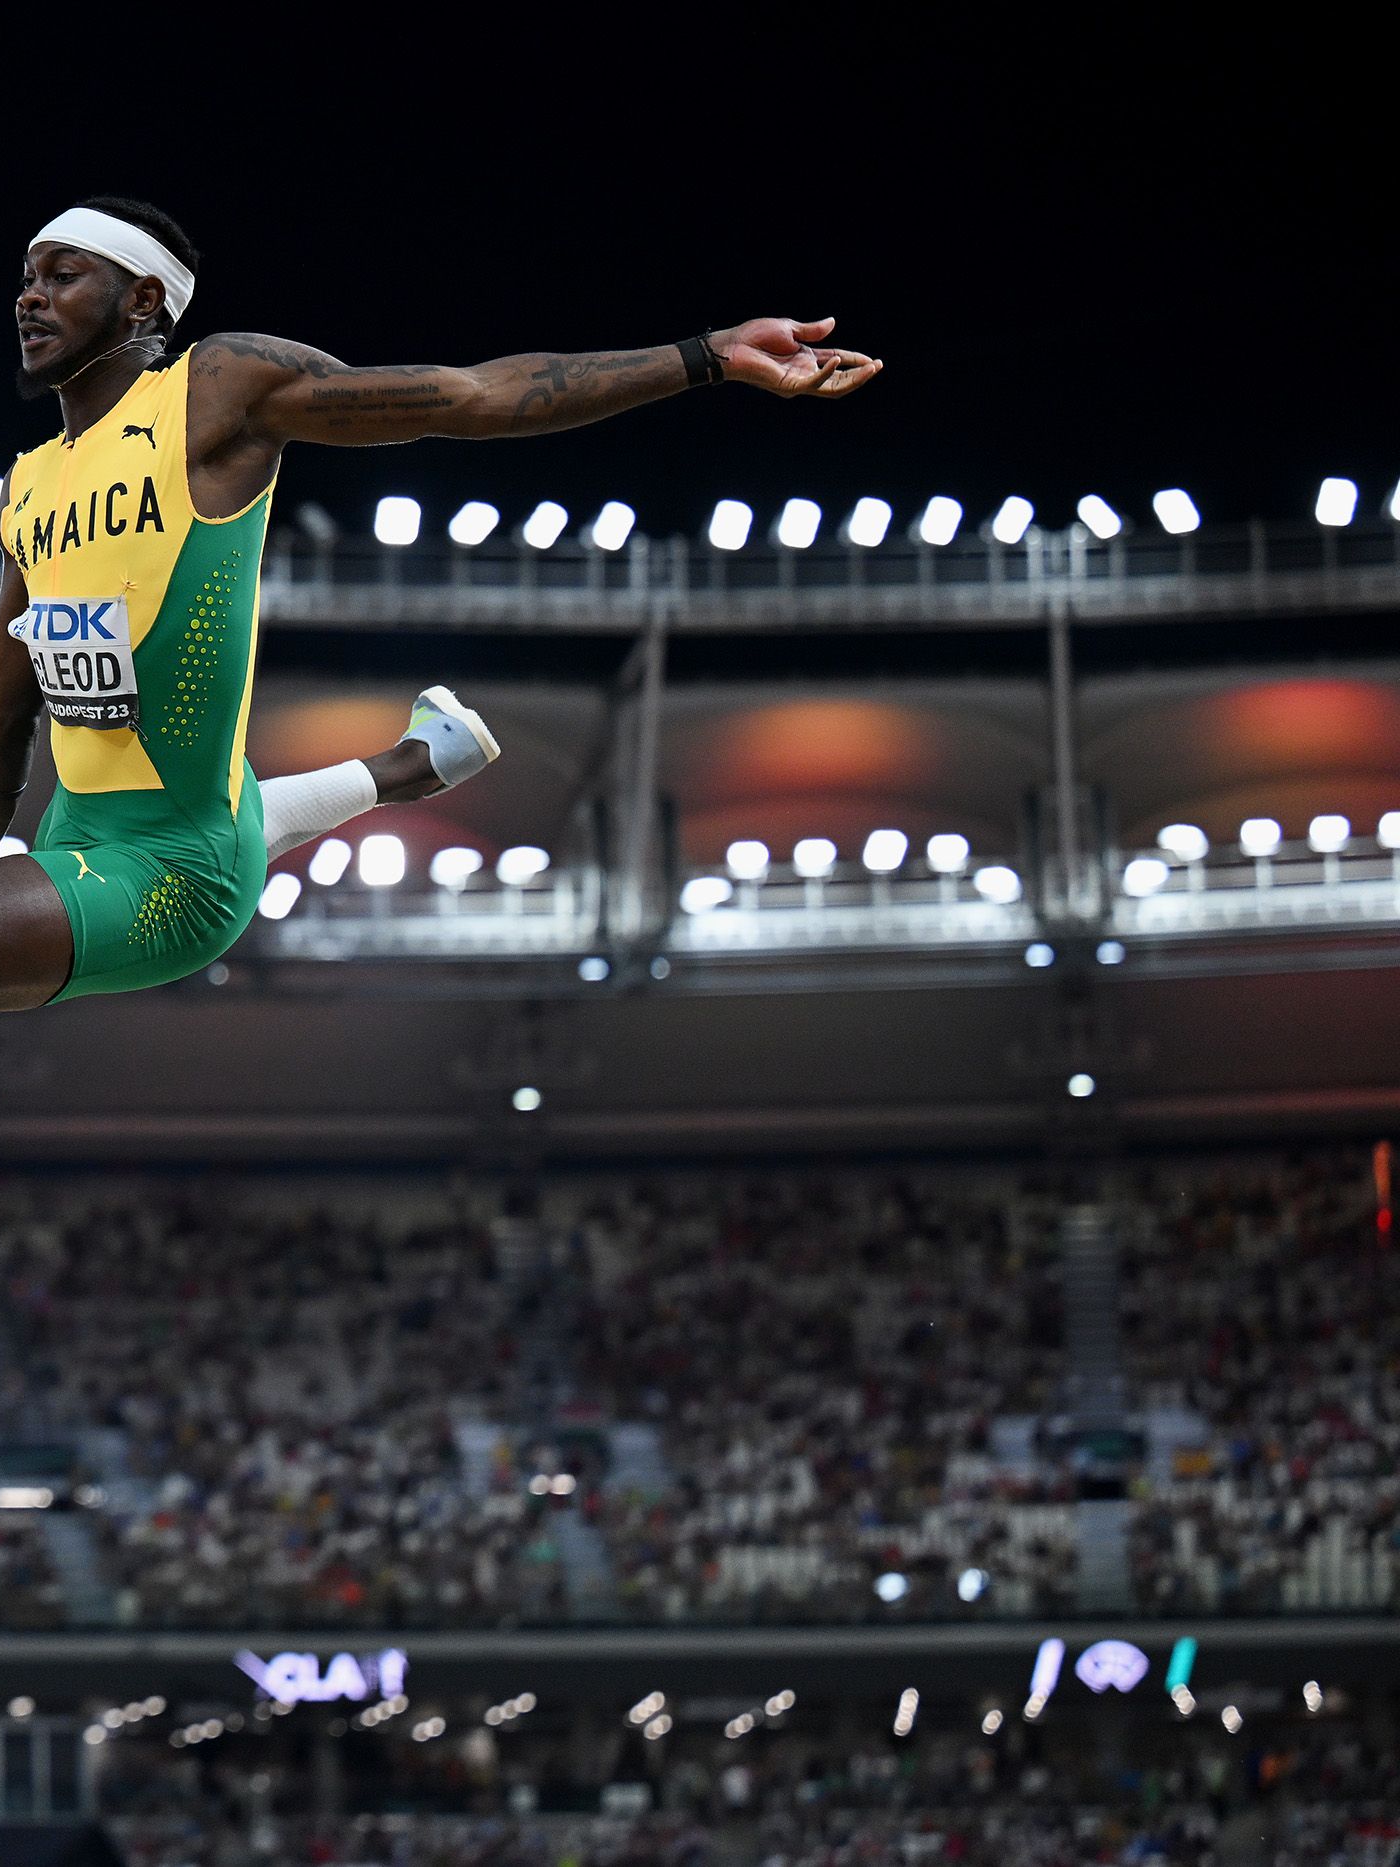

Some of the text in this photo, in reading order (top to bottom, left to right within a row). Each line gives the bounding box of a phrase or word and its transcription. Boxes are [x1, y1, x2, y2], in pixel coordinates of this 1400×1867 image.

[312, 384, 440, 400] Nothing is impossible
[11, 476, 165, 570] AMAICA
[31, 602, 117, 641] TDK
[33, 651, 122, 692] cLEOD
[48, 701, 130, 720] BUDAPEST 23
